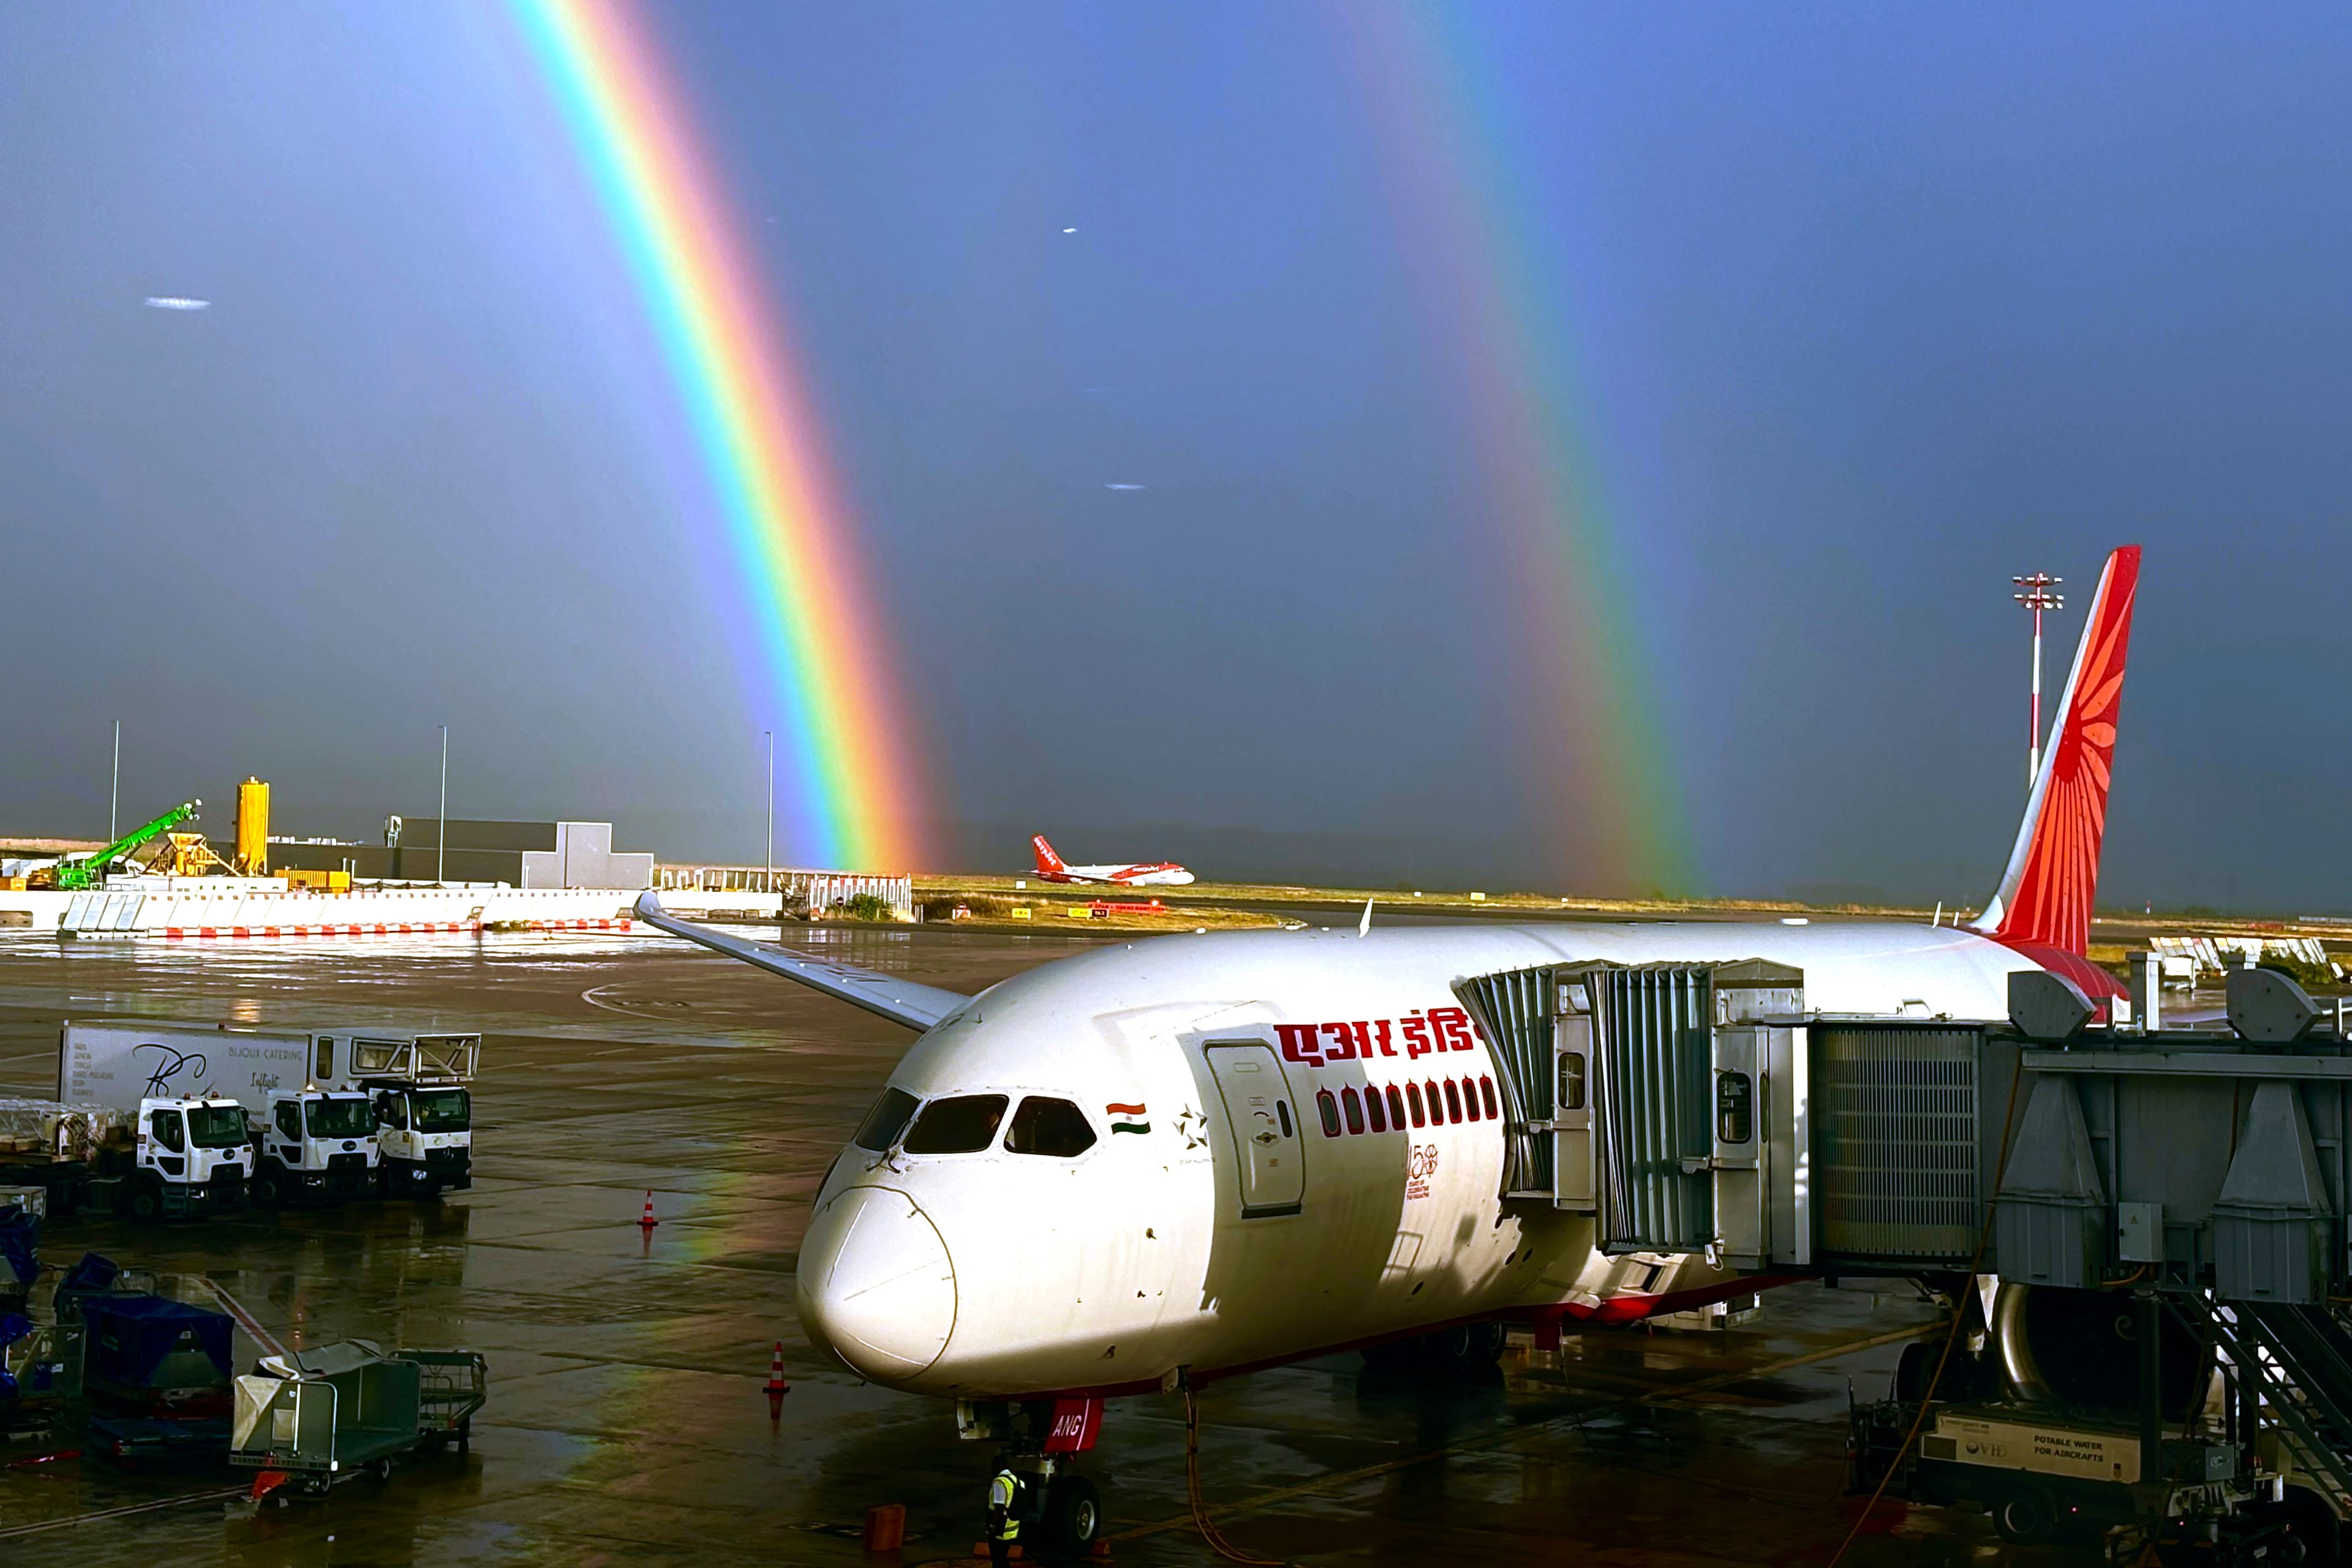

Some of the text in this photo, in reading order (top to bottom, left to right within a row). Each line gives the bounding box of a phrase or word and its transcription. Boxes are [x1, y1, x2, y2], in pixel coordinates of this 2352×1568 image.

[1273, 1007, 1483, 1068] एअर इंडि
[228, 1046, 303, 1061] BIJOUX CATERING
[250, 1072, 281, 1095] Inflight
[1052, 1414, 1082, 1437] ANG
[2034, 1435, 2102, 1450] POTABLE WATER
[2034, 1446, 2104, 1462] FOR AIRCRAFTS
